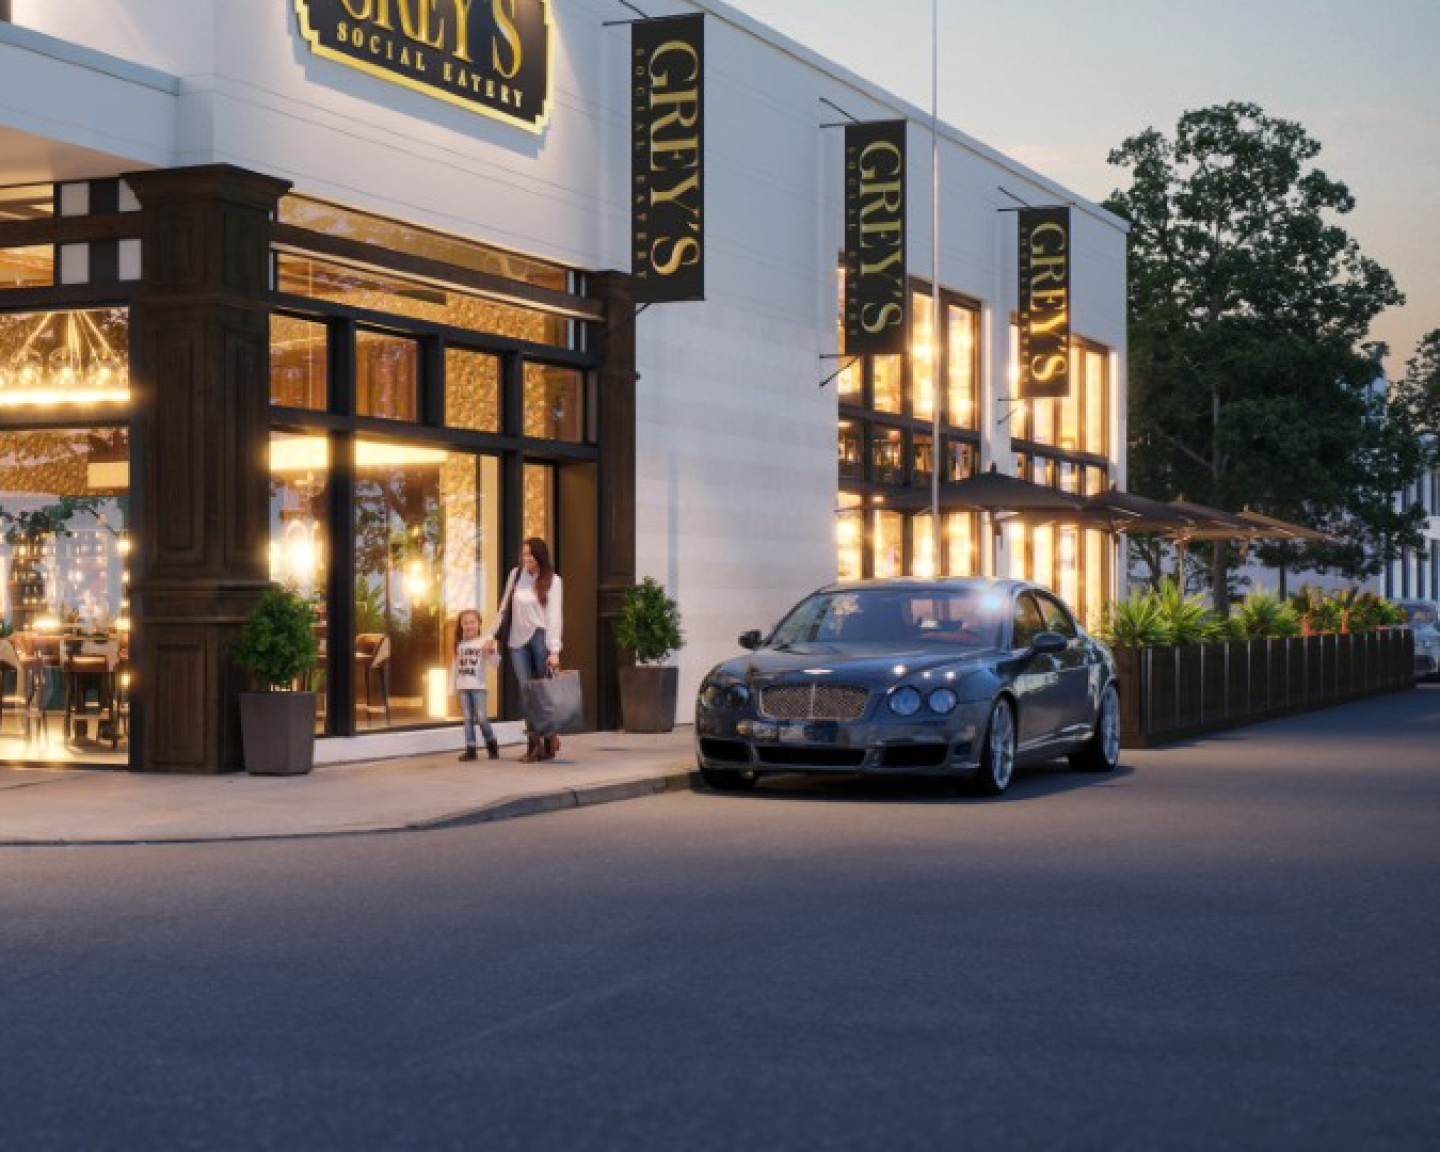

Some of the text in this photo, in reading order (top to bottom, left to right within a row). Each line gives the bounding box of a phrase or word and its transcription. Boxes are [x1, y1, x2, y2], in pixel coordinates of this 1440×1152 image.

[336, 20, 425, 71] SOCIAL
[649, 40, 700, 276] GREY'S
[860, 140, 903, 334] GREY'S
[1030, 222, 1067, 381] GREY'S
